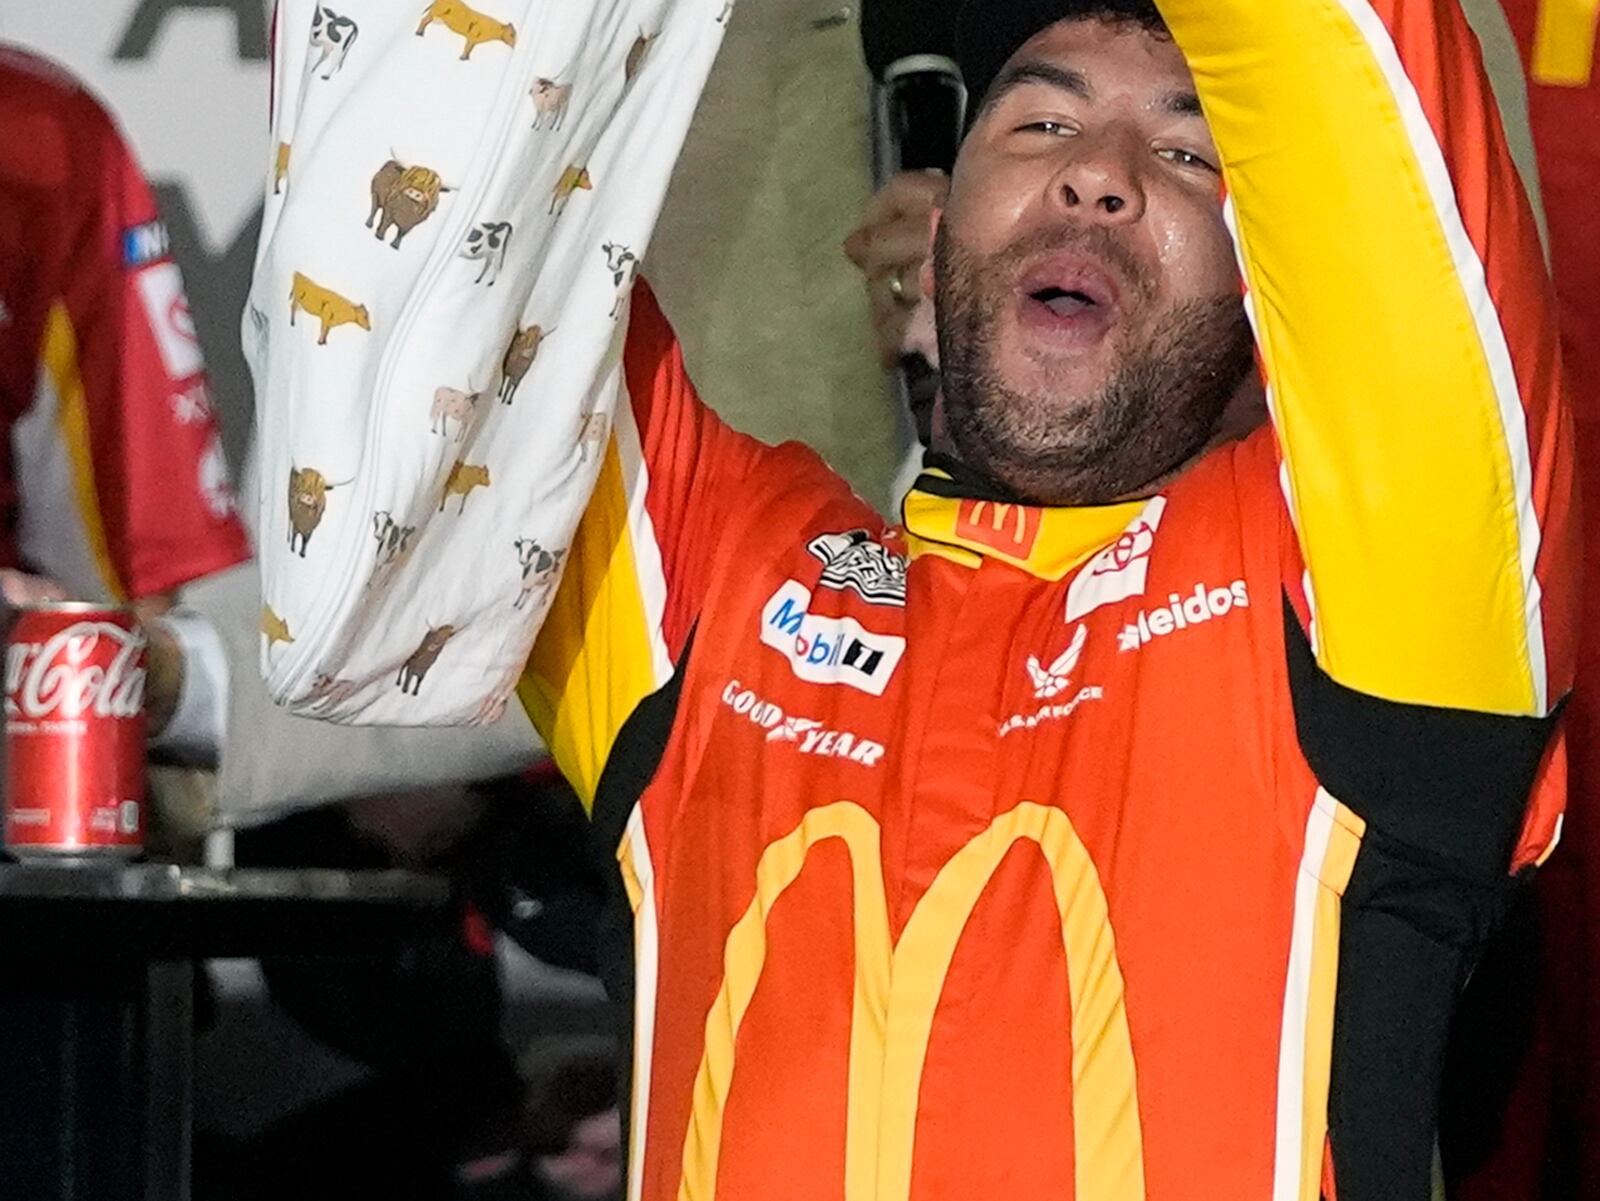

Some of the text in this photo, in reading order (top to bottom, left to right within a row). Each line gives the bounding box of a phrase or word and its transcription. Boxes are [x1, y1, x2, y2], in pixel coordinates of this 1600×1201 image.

[769, 597, 846, 667] Mobil
[1136, 579, 1250, 644] leidos
[721, 678, 886, 768] GOODYEAR
